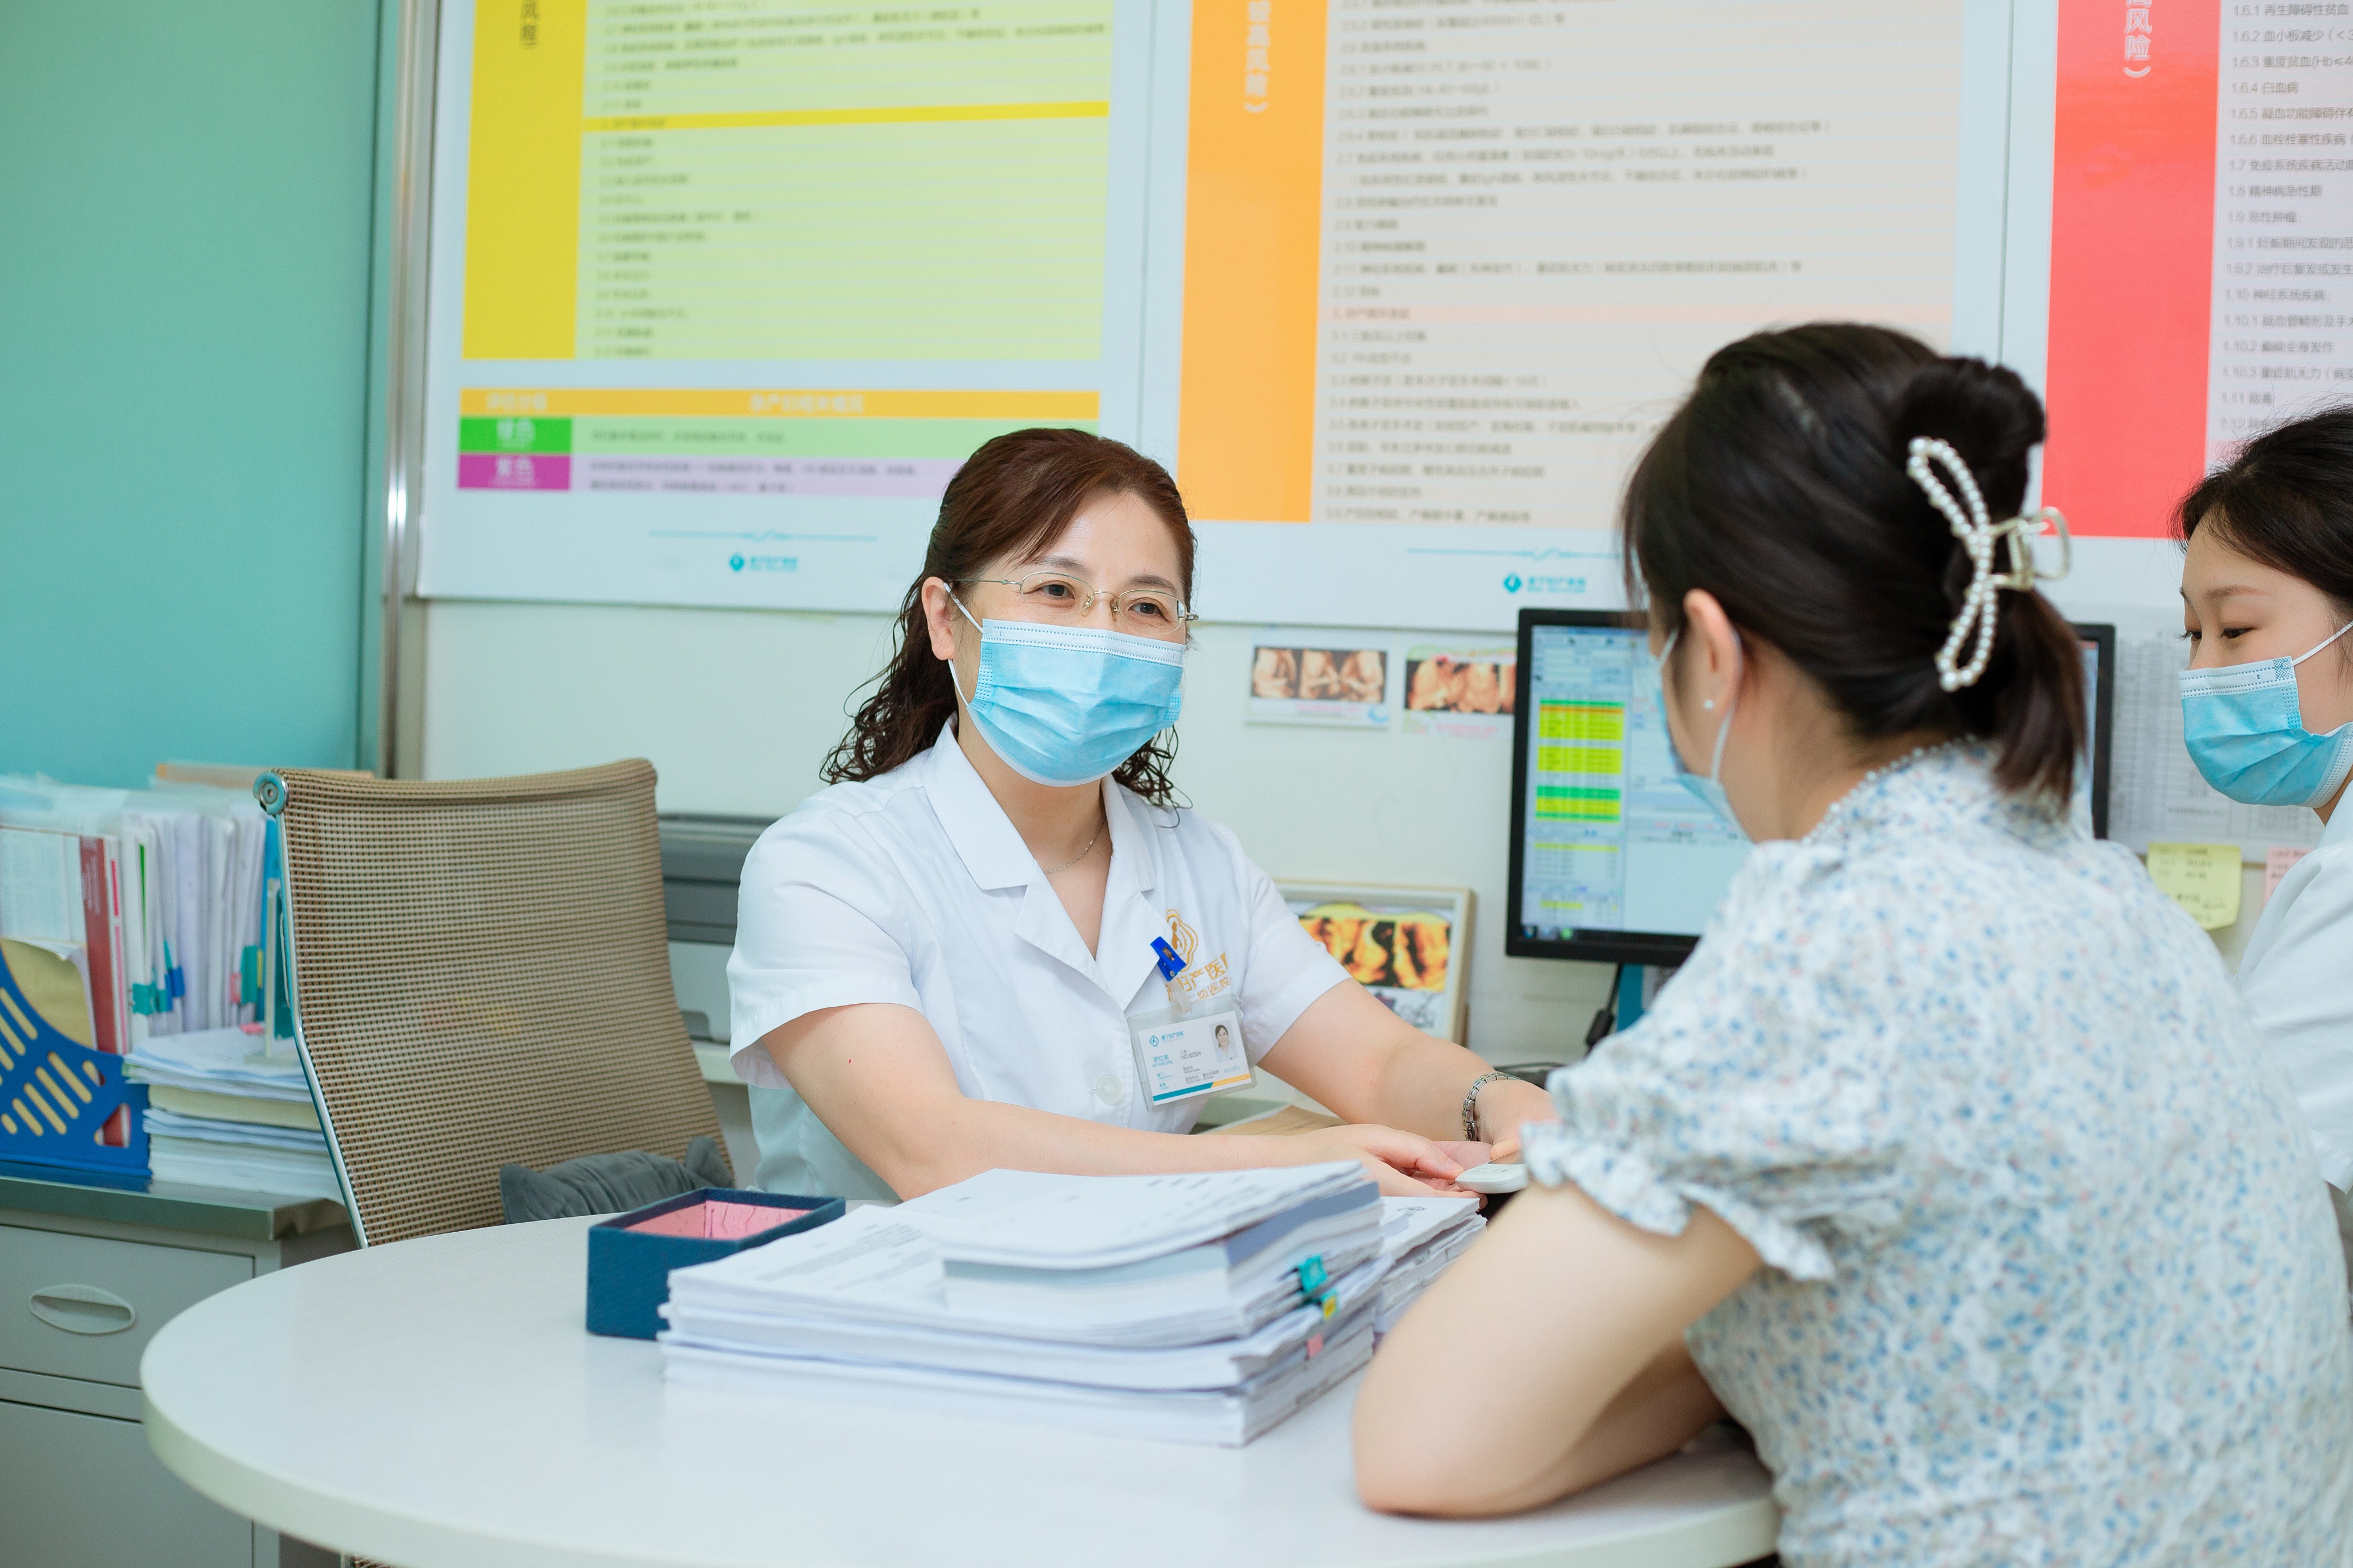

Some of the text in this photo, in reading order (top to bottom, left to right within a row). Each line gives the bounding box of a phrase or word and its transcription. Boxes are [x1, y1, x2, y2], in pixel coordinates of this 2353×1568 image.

[2233, 4, 2349, 17] 1.6.1 再生障碍性贫血
[2123, 0, 2152, 78] 风险）
[2233, 30, 2260, 42] 1.6.2
[2232, 55, 2260, 68] 1.6.3
[2231, 81, 2300, 94] 1.6.4 白血病
